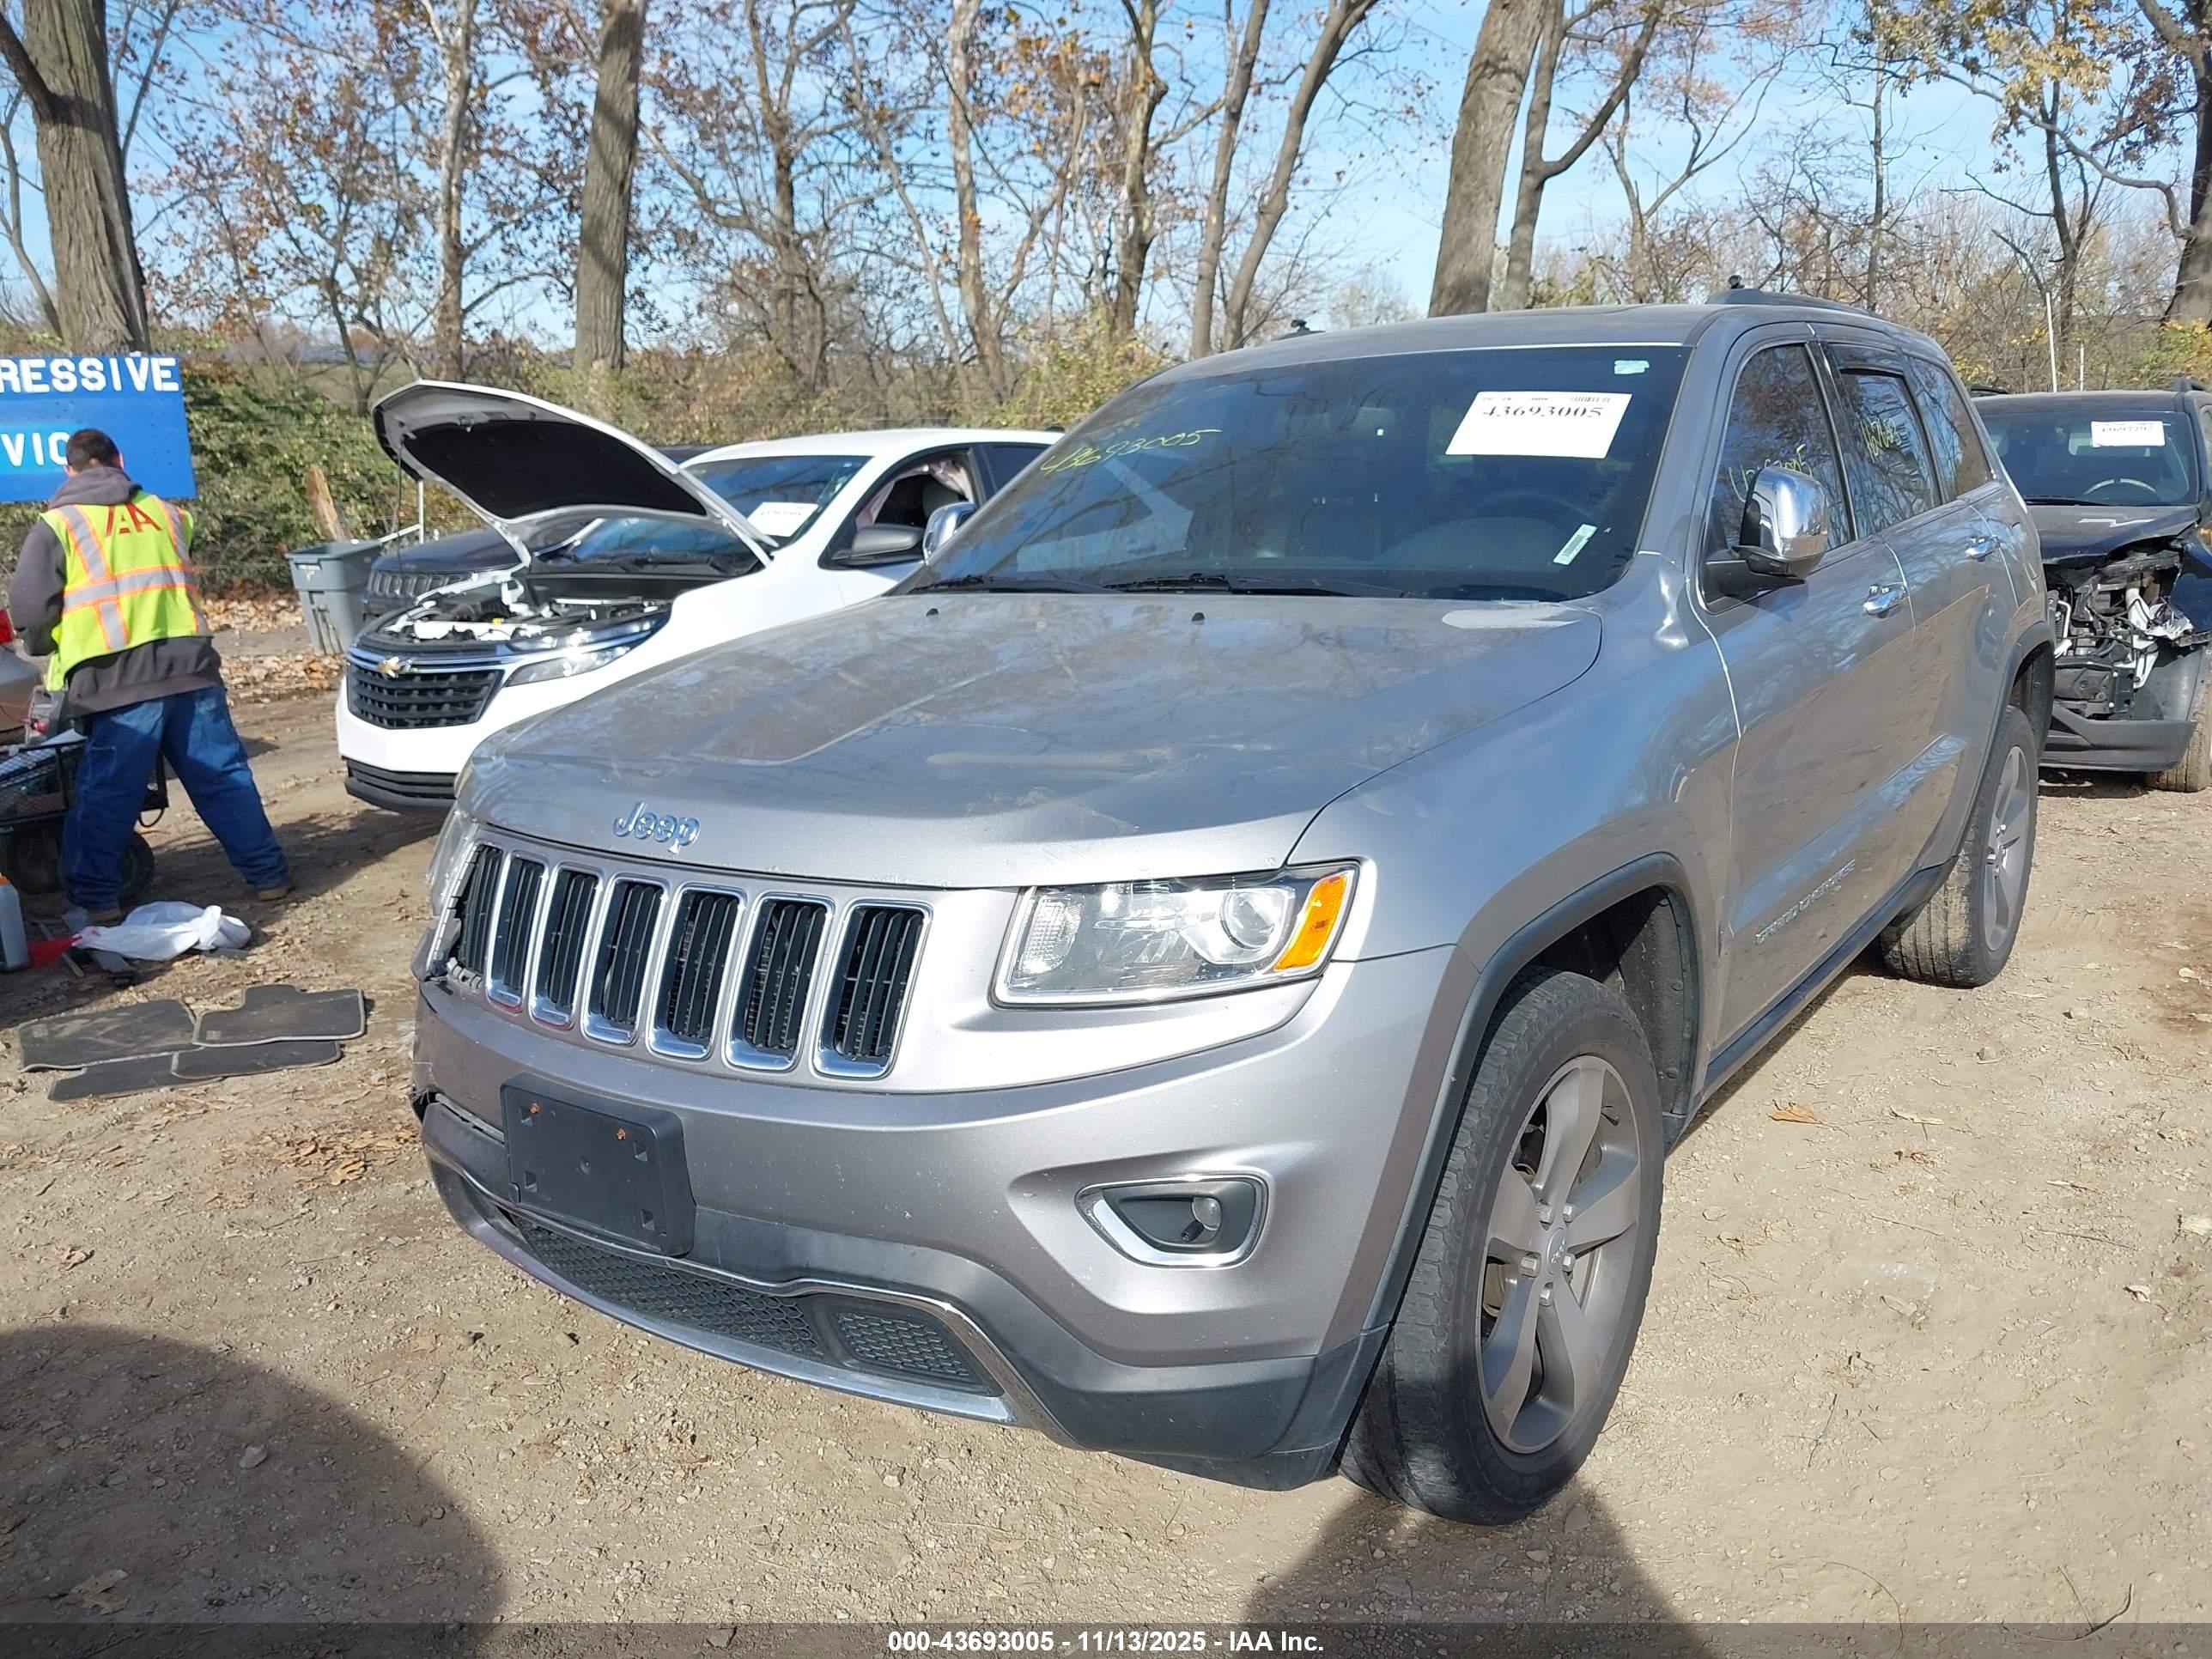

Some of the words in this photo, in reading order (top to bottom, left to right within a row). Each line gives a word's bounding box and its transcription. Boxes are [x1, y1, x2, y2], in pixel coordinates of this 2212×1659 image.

[0, 357, 179, 392] RESSIVE
[1482, 406, 1603, 417] 43693005
[613, 801, 701, 854] Jeep
